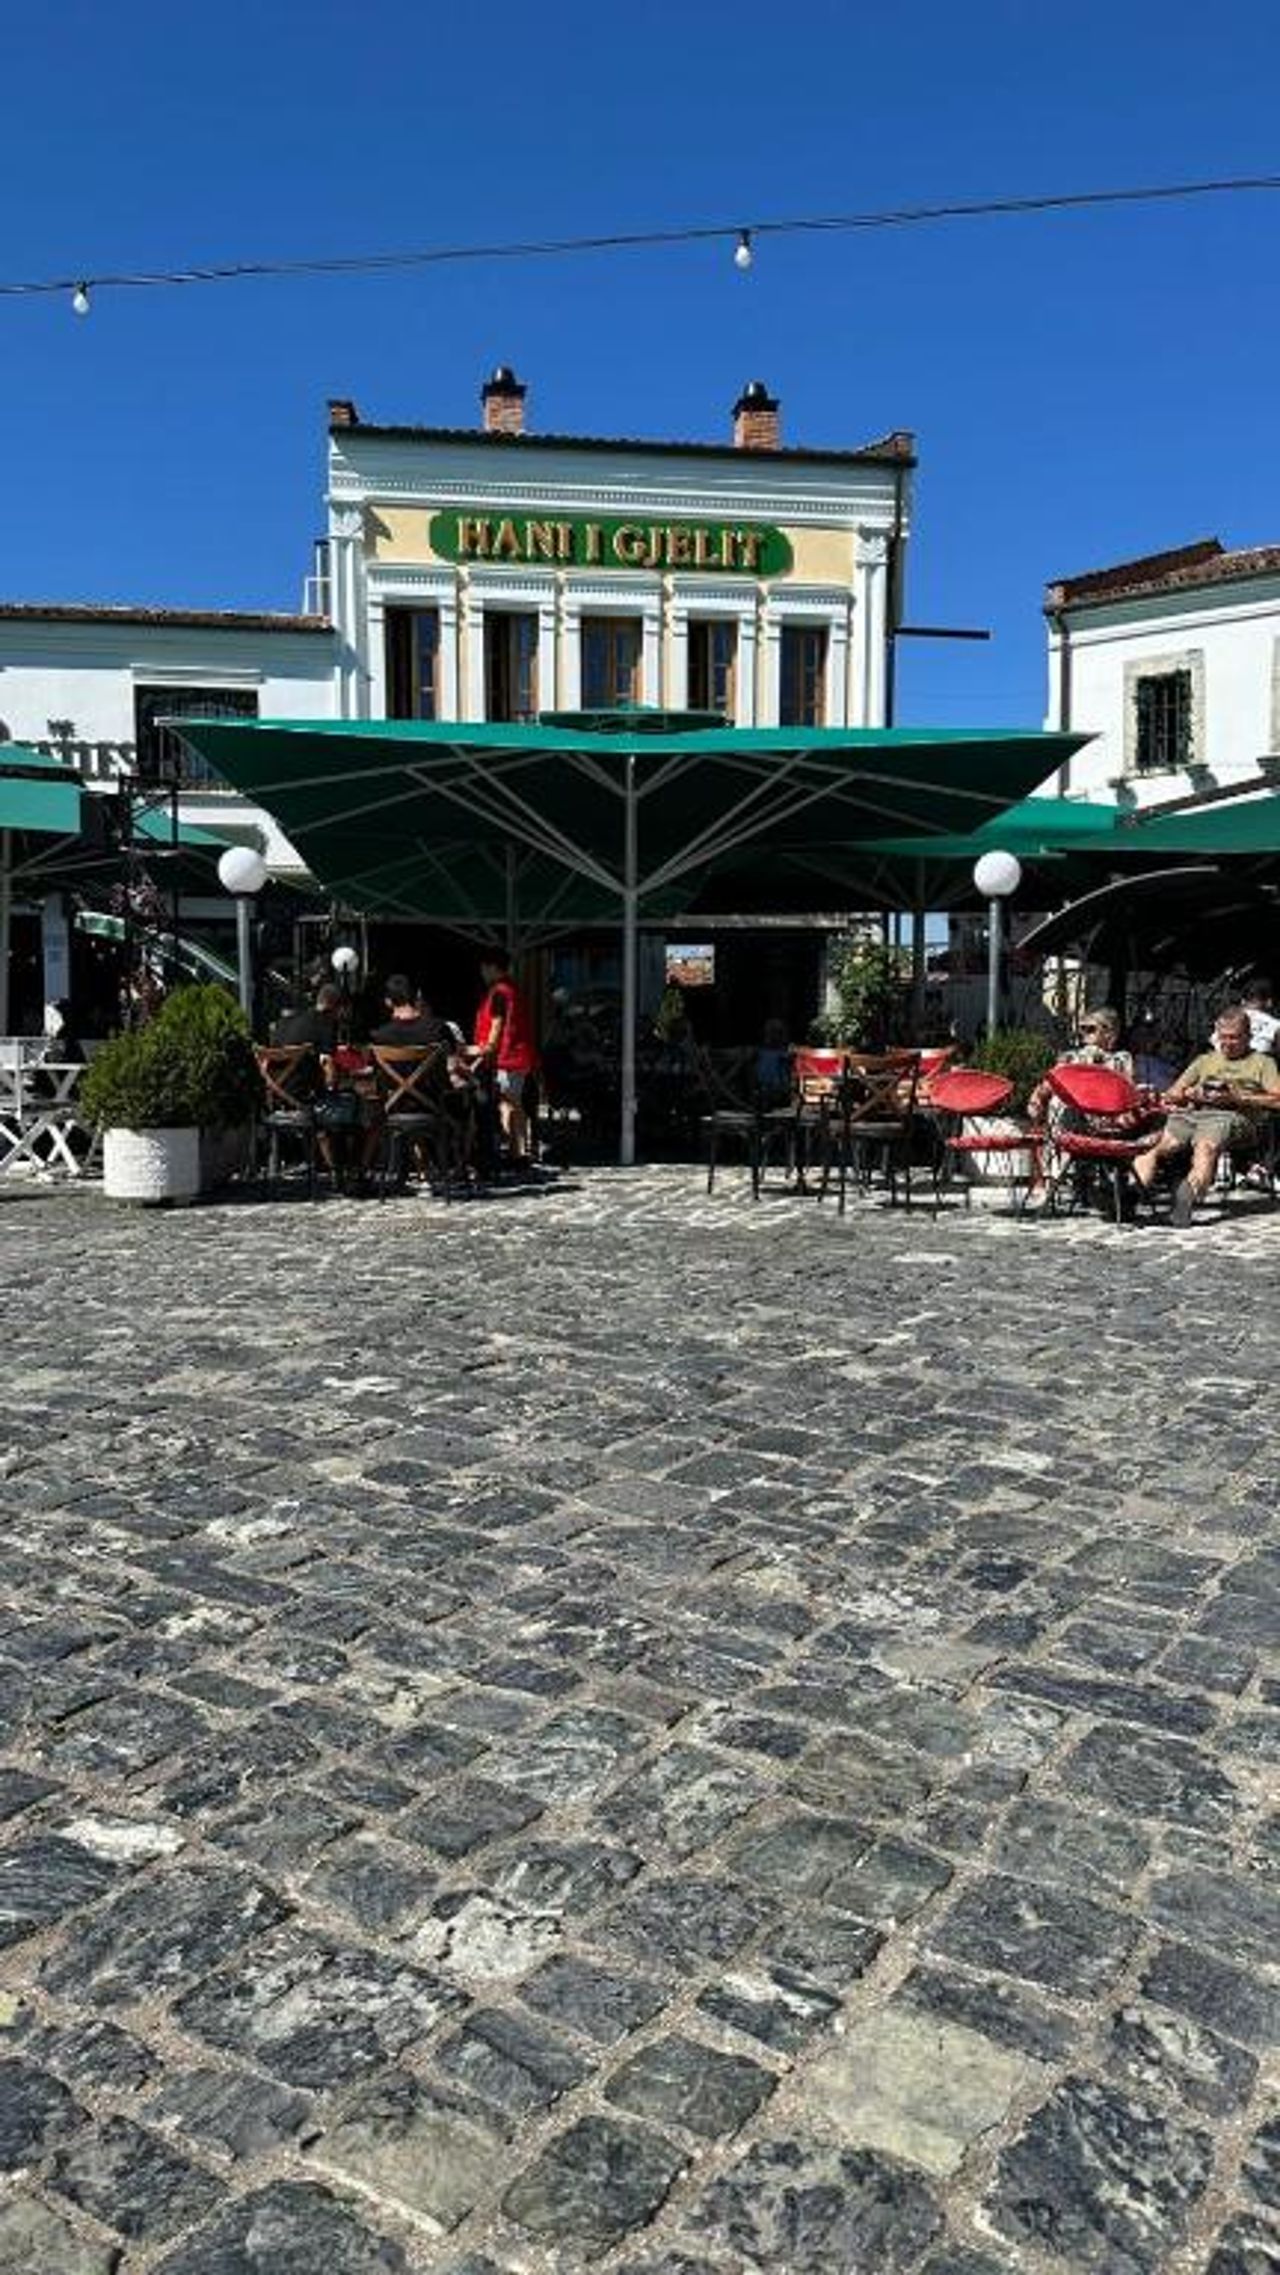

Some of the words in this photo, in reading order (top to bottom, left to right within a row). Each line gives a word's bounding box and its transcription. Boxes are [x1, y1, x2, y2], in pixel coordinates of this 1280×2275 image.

[456, 516, 573, 559] HANI
[586, 522, 602, 560] I
[613, 524, 765, 568] GJELIT
